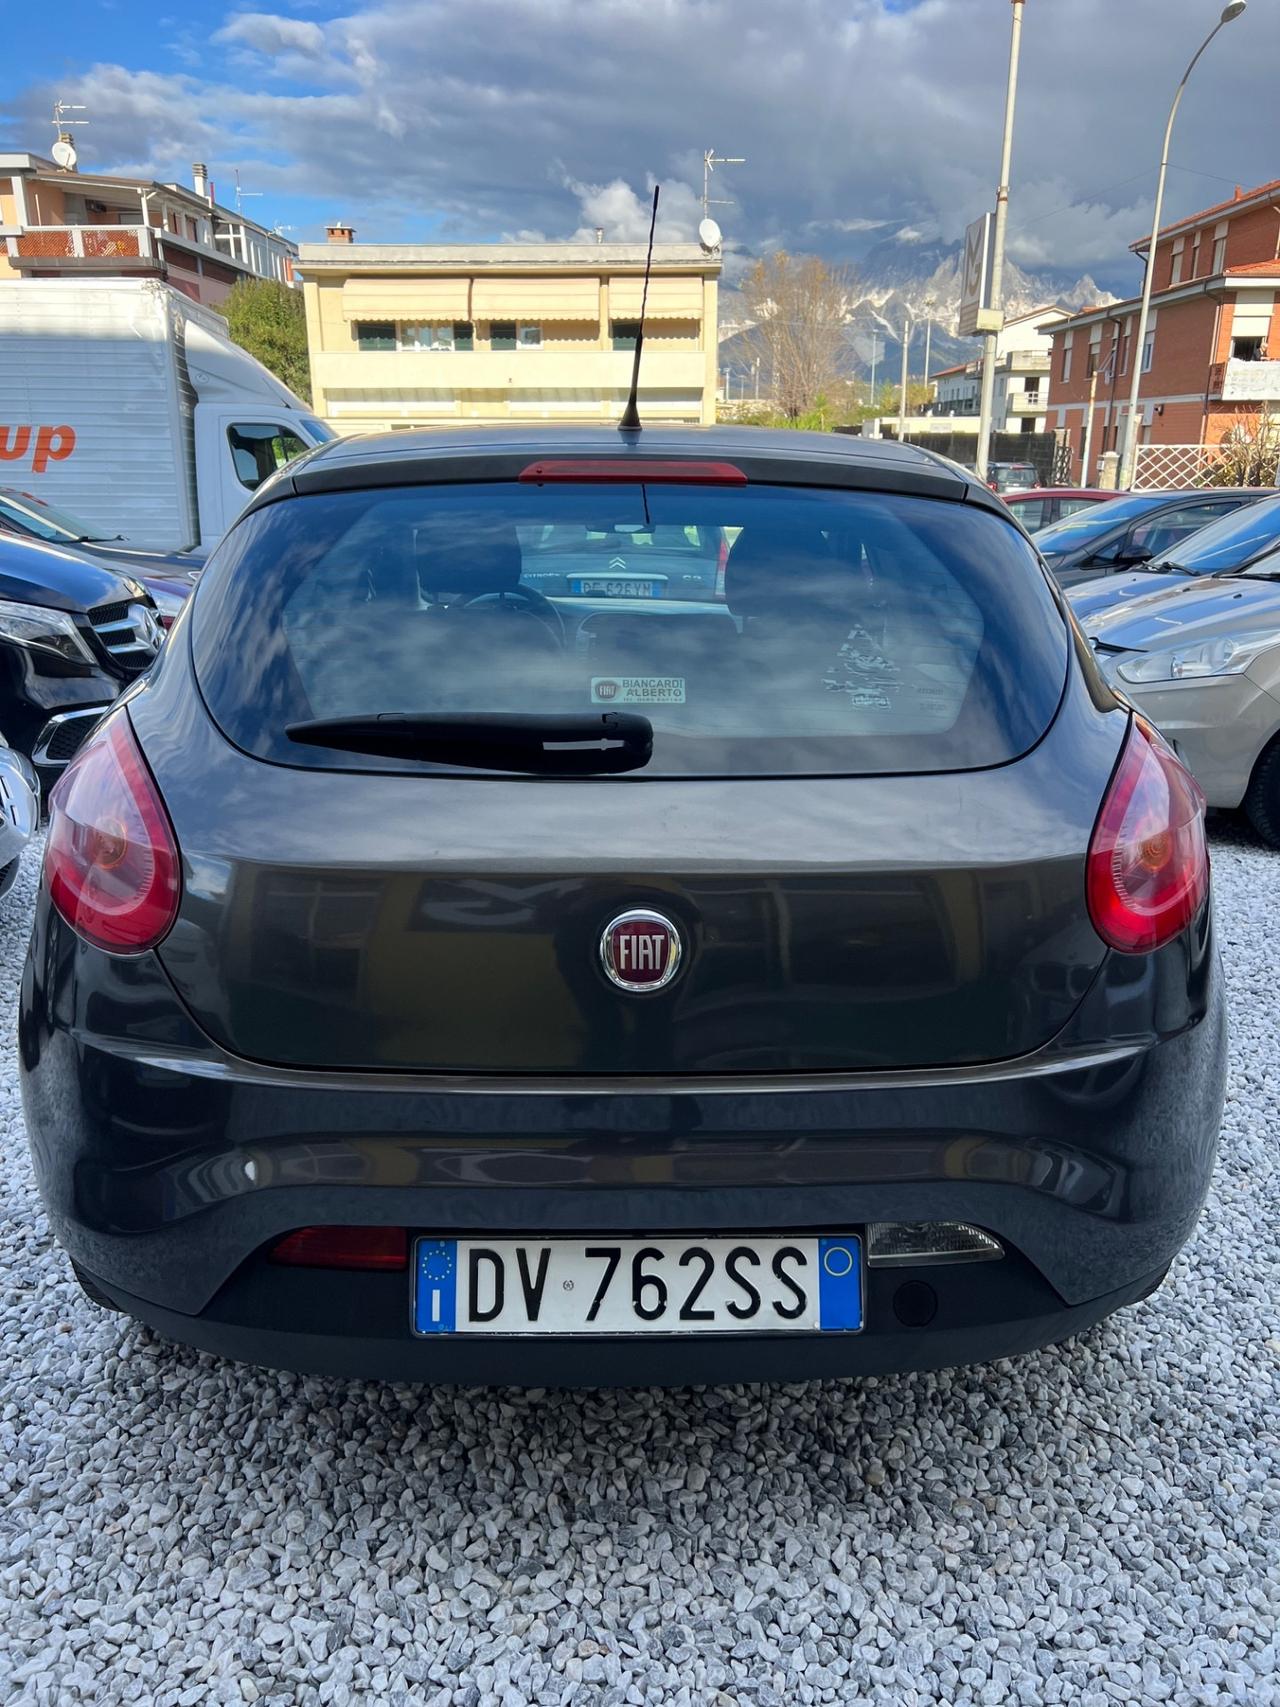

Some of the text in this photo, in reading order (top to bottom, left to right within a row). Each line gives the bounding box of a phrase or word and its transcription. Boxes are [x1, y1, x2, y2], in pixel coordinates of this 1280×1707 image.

[0, 424, 76, 473] up
[622, 679, 683, 688] BIANCARDI
[626, 688, 682, 697] ALBERTO
[619, 934, 665, 970] FIAT
[468, 1246, 808, 1322] DV 762SS
